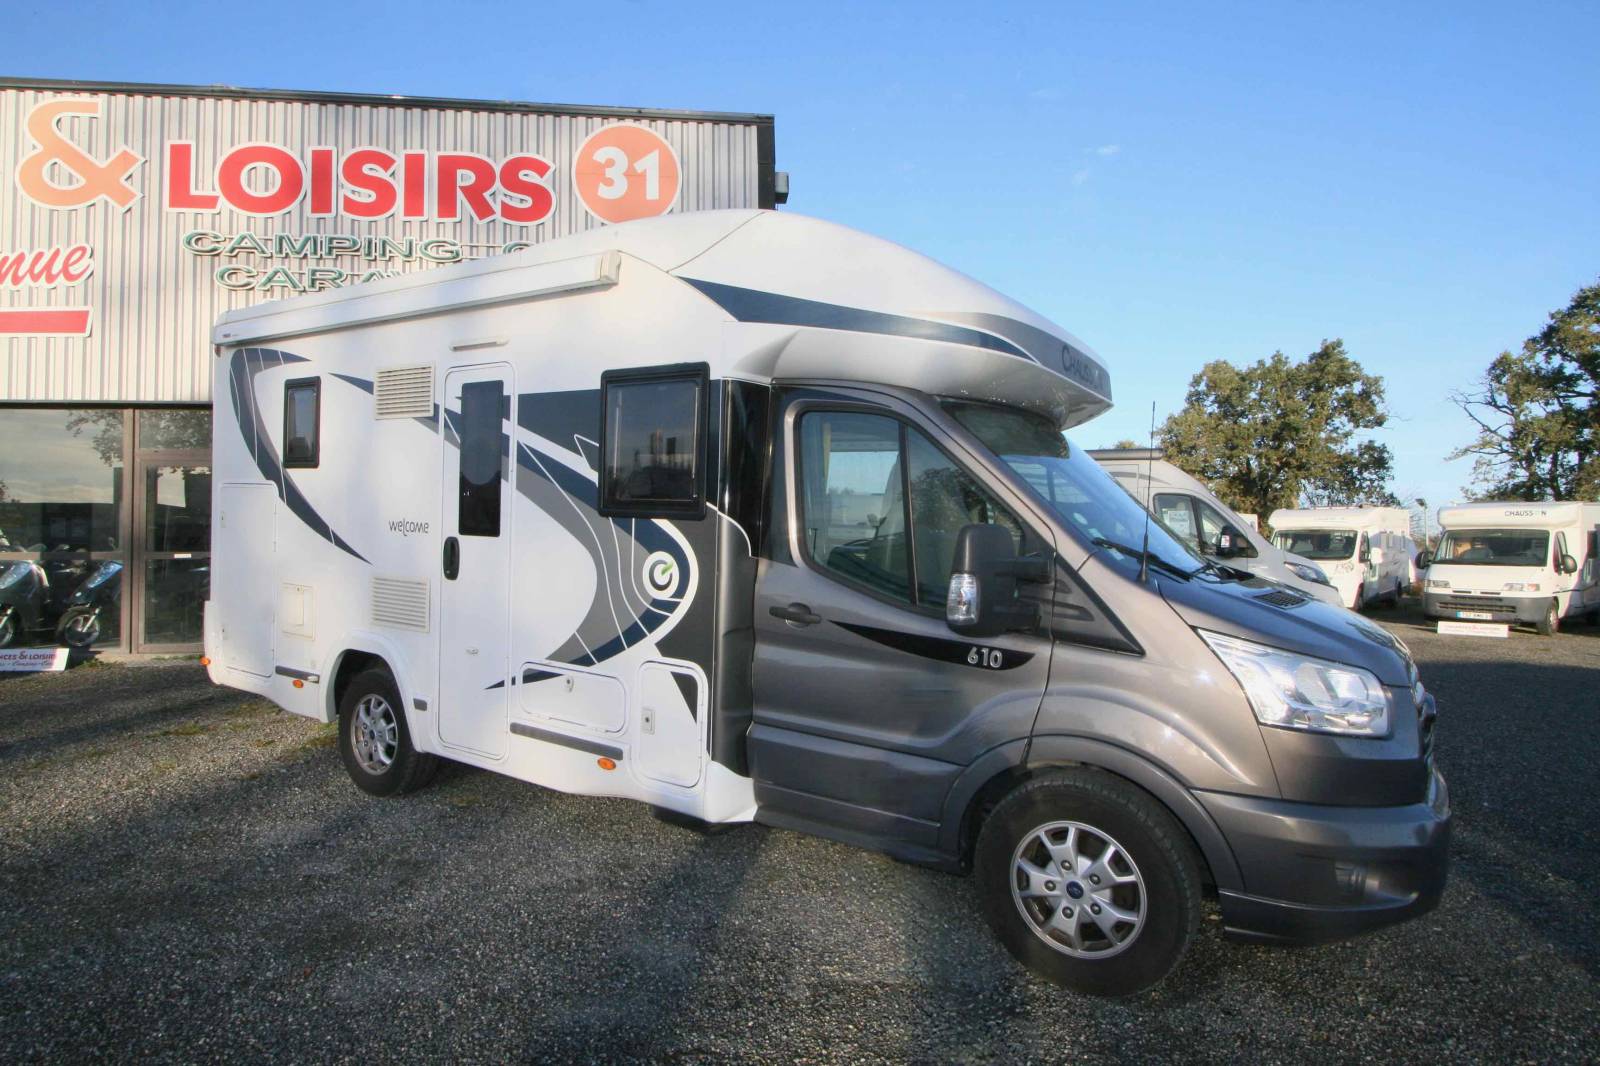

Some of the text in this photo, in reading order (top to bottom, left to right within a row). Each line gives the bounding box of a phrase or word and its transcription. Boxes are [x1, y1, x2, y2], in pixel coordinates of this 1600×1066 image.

[17, 98, 660, 224] & LOISIRS 31
[183, 230, 462, 263] CAMPING
[388, 518, 430, 537] welcome
[967, 646, 1003, 669] 610
